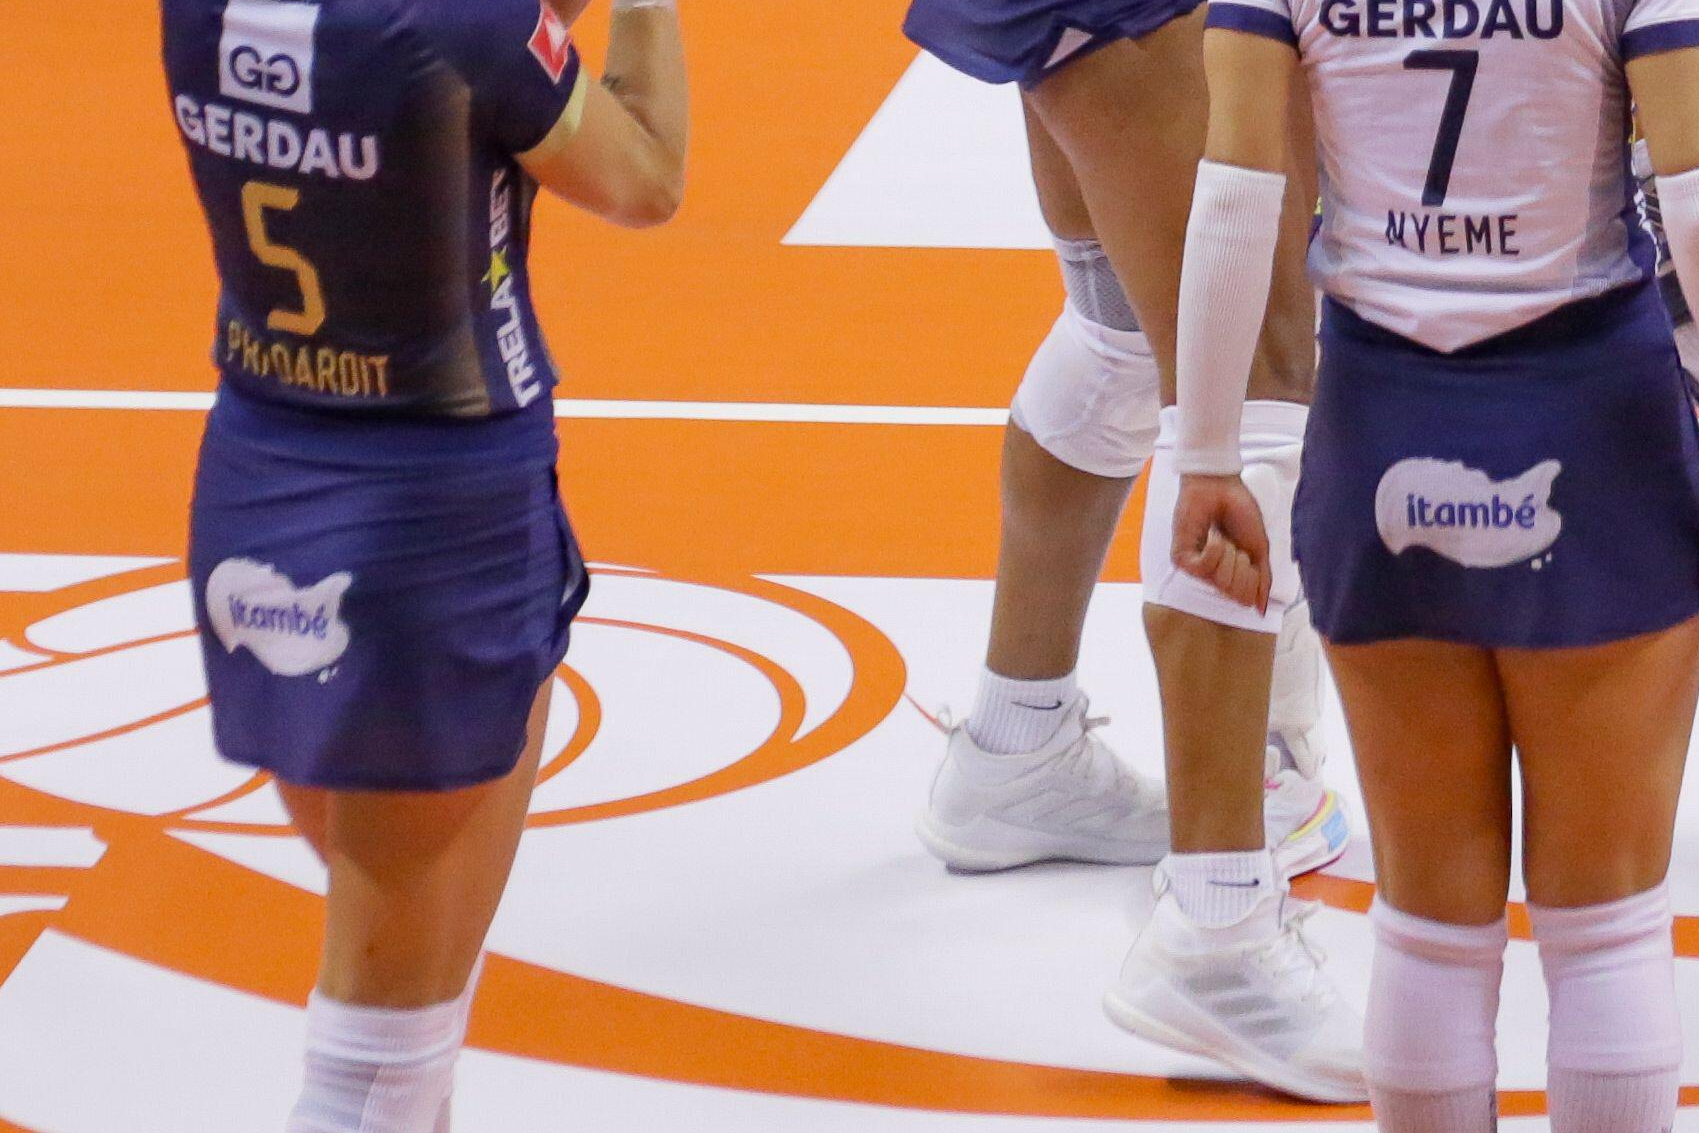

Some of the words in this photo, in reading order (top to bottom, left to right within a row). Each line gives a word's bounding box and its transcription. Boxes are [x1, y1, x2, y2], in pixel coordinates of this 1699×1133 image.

[174, 93, 381, 181] GERDAU
[1403, 49, 1480, 206] 7
[240, 180, 327, 336] 5
[1385, 209, 1520, 256] NYEME
[1407, 493, 1536, 529] itambé
